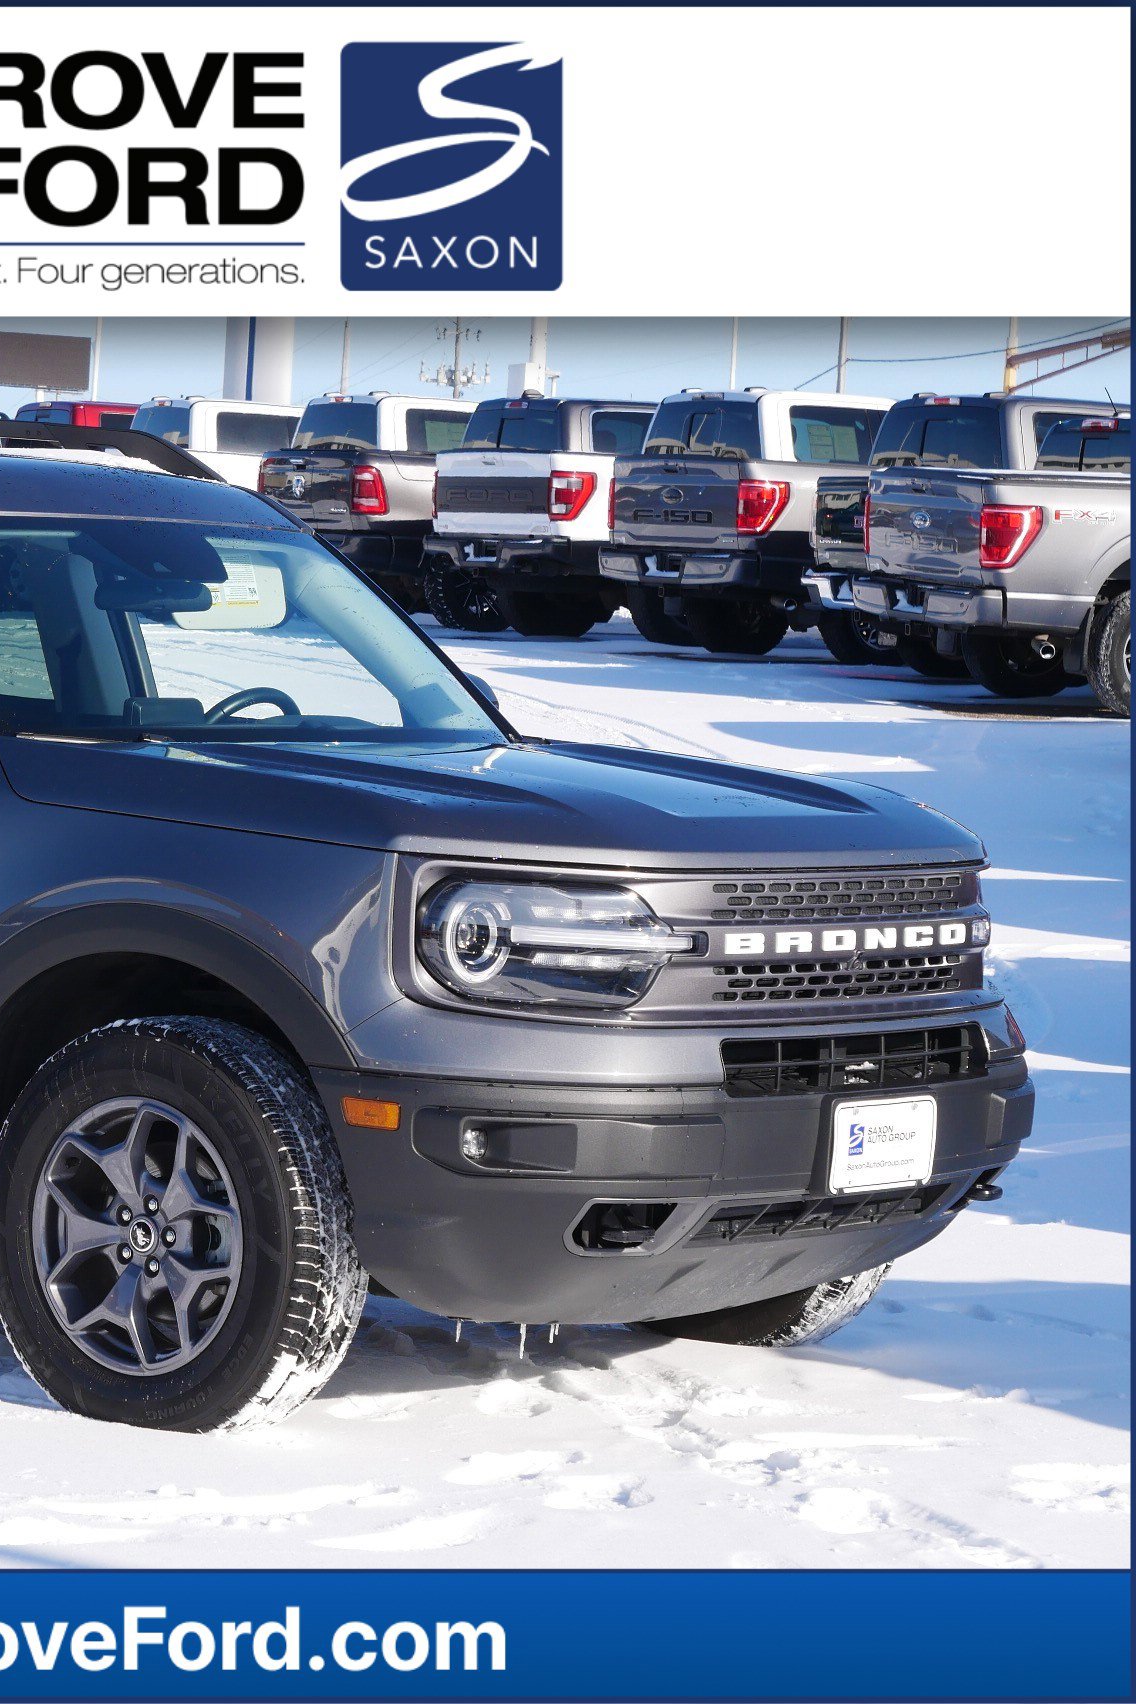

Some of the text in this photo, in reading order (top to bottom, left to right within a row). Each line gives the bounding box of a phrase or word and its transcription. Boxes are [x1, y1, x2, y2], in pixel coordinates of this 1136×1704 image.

[633, 509, 714, 524] F-150
[1054, 508, 1117, 522] FX4
[724, 923, 966, 955] BRONCO
[867, 1125, 894, 1136] SAXON
[867, 1132, 916, 1144] AUTO GROUP
[847, 1159, 915, 1171] SaxonAutoGroup.com
